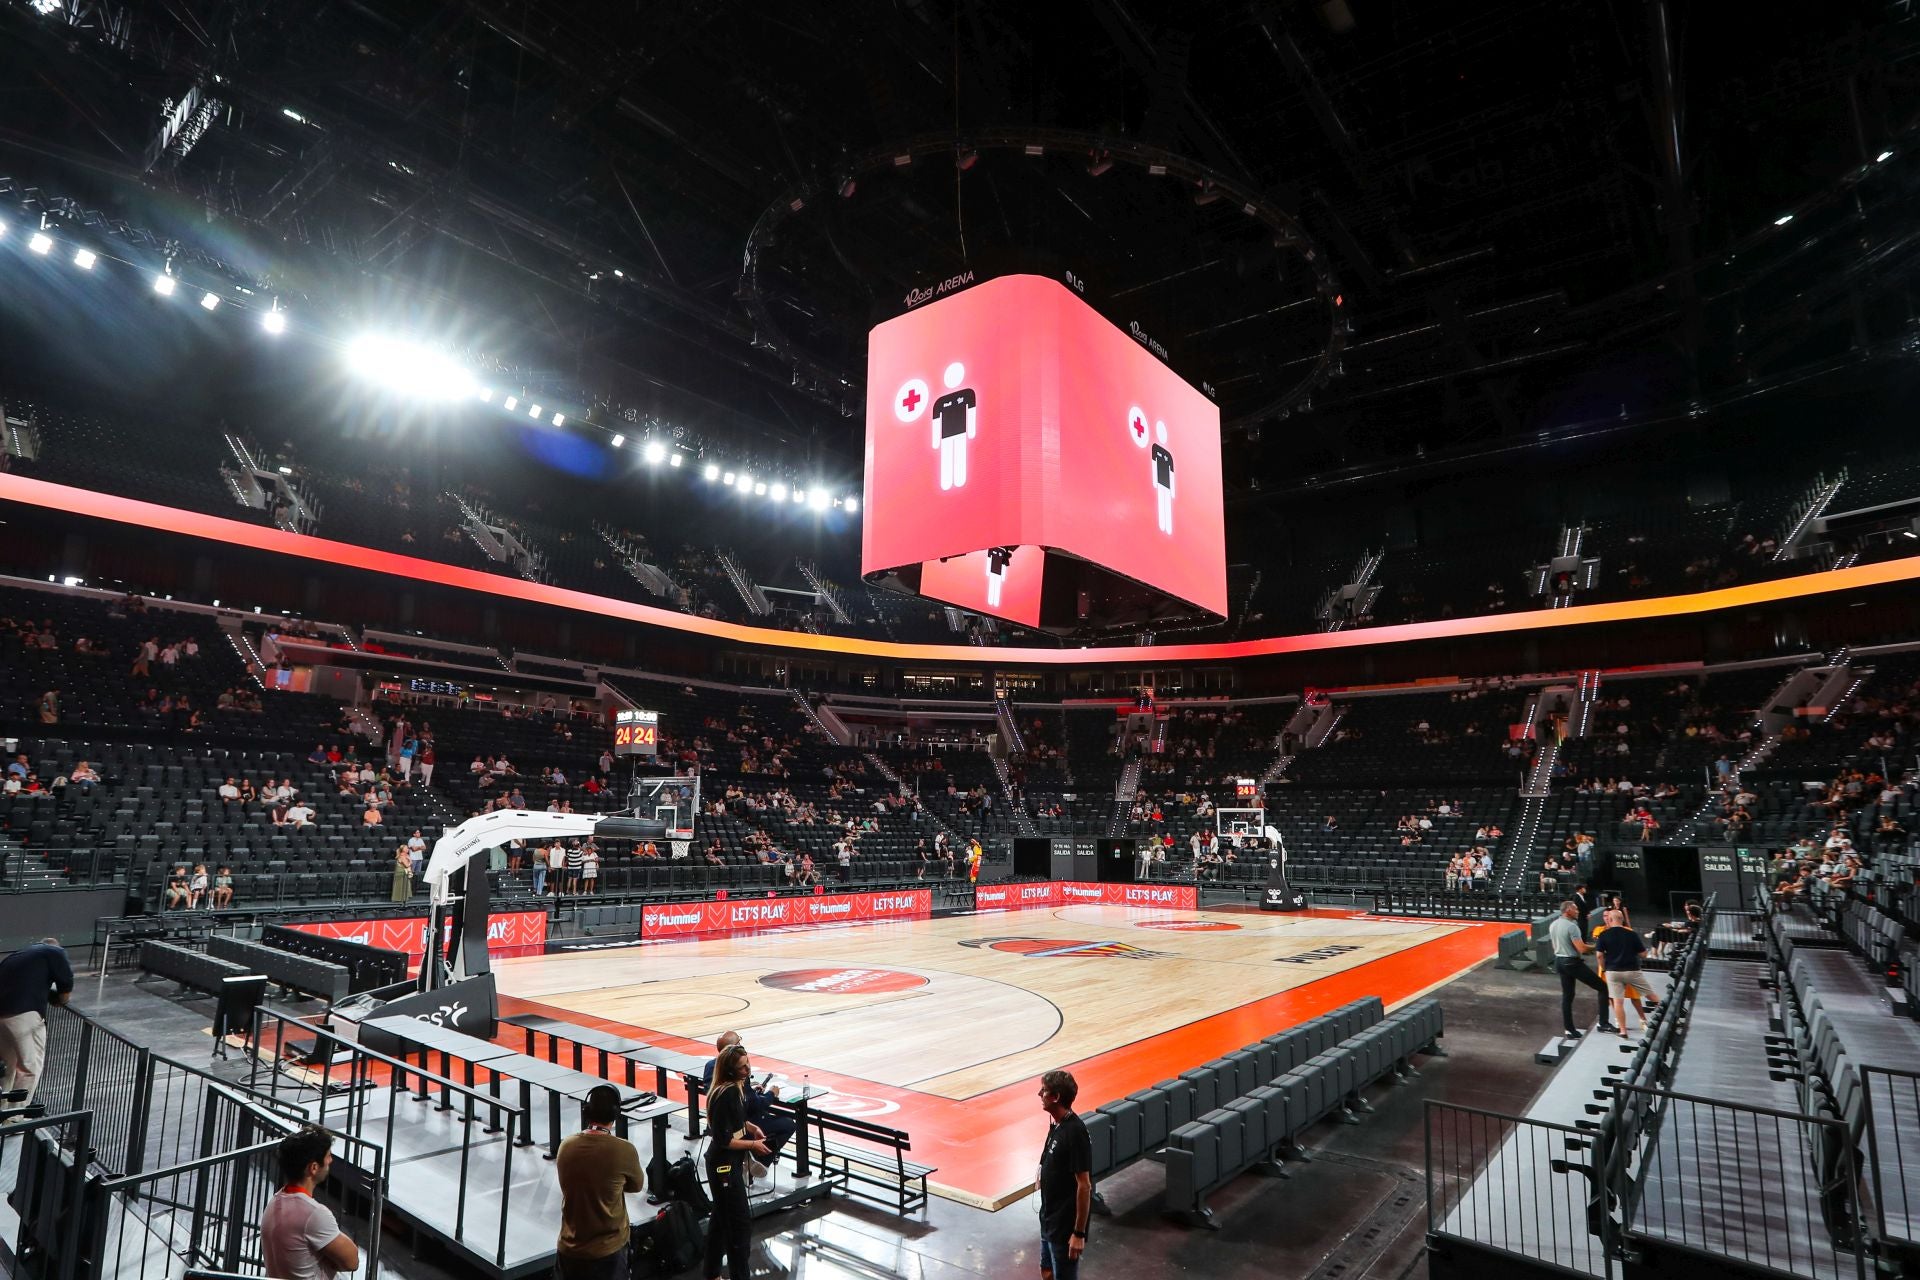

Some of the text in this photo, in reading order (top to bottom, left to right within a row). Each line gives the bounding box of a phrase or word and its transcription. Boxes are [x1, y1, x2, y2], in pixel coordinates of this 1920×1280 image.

[936, 270, 974, 295] ARENA
[1073, 275, 1084, 292] LG
[1149, 338, 1169, 361] ARENA
[617, 727, 630, 744] 24
[634, 727, 654, 744] 24
[1238, 786, 1249, 795] 24
[1615, 861, 1640, 869] SALIDA
[1704, 864, 1732, 872] SALIDA
[1037, 886, 1050, 897] PLAY
[1072, 887, 1173, 901] hummel LET'S PLAY
[820, 896, 913, 914] hummel LET'S PLAY
[659, 905, 784, 926] hummel LET'S PLAY
